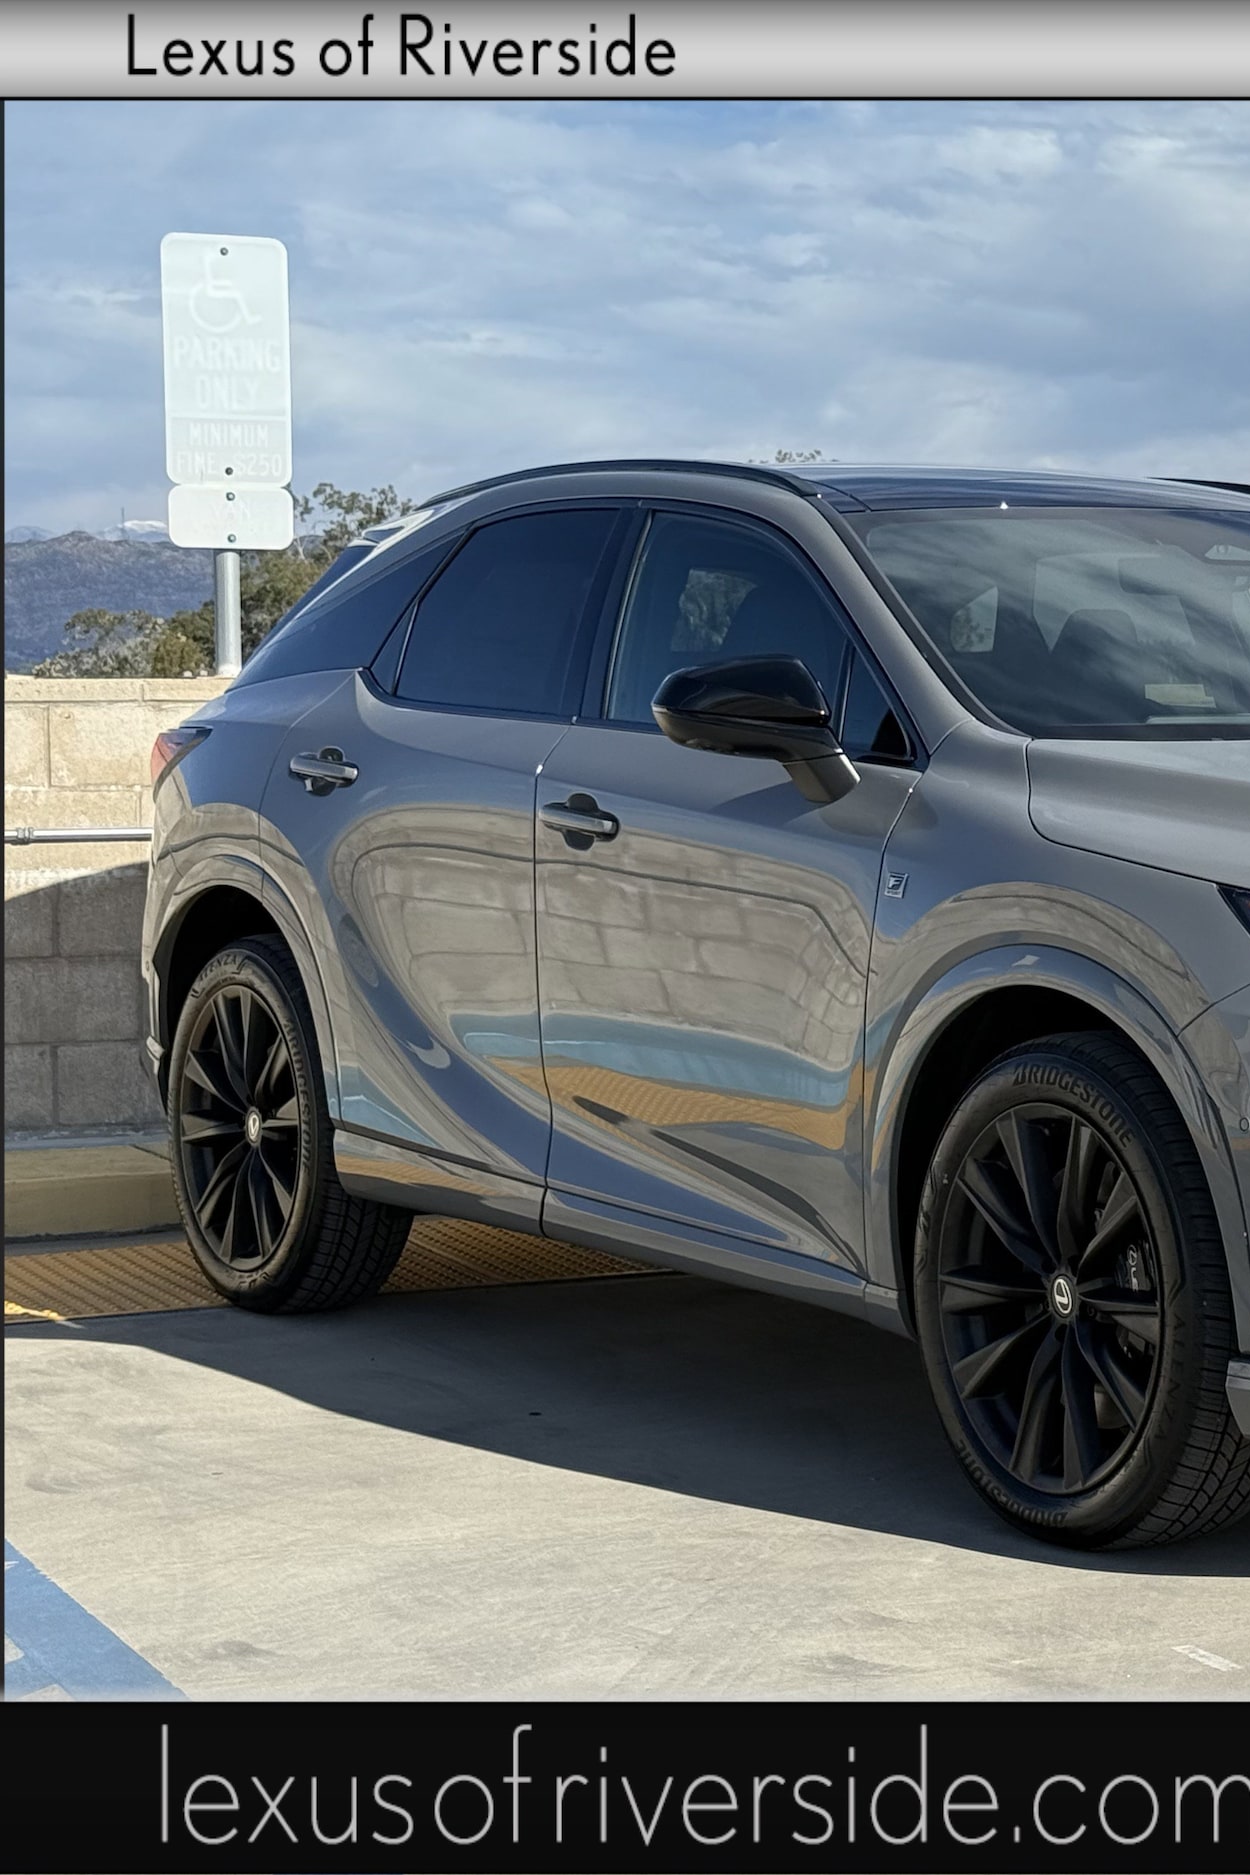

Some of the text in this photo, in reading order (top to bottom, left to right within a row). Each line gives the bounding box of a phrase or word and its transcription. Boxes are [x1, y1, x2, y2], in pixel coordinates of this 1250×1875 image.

[174, 336, 281, 372] PARKING
[196, 375, 258, 410] ONLY
[190, 422, 268, 448] MINIMUM
[176, 450, 283, 477] FINE $250
[1012, 1062, 1136, 1149] BRIDGESTONE
